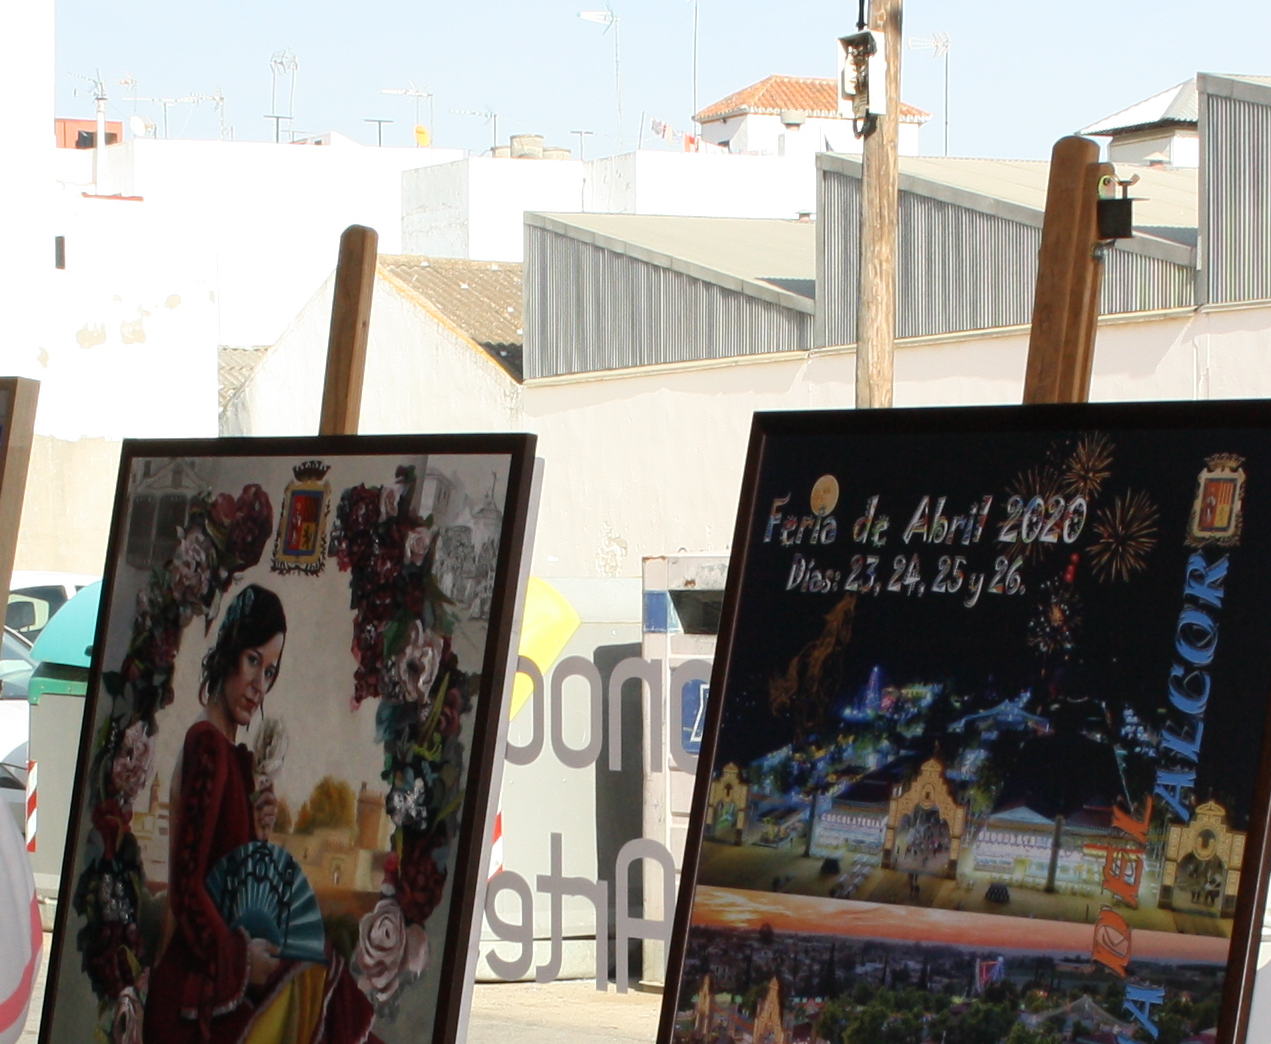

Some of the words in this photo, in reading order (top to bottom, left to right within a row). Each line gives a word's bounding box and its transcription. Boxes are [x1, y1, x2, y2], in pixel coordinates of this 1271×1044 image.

[763, 492, 838, 547] Feria
[853, 494, 890, 547] de
[903, 495, 993, 546] Abril
[997, 494, 1087, 544] 2020
[785, 553, 841, 593] Días:
[844, 554, 881, 597] 23,
[887, 552, 926, 598] 24,
[931, 555, 967, 593] 25
[963, 572, 985, 608] y
[987, 555, 1026, 595] 26.
[1093, 794, 1155, 977] DEL
[1152, 548, 1230, 823] ALCOR
